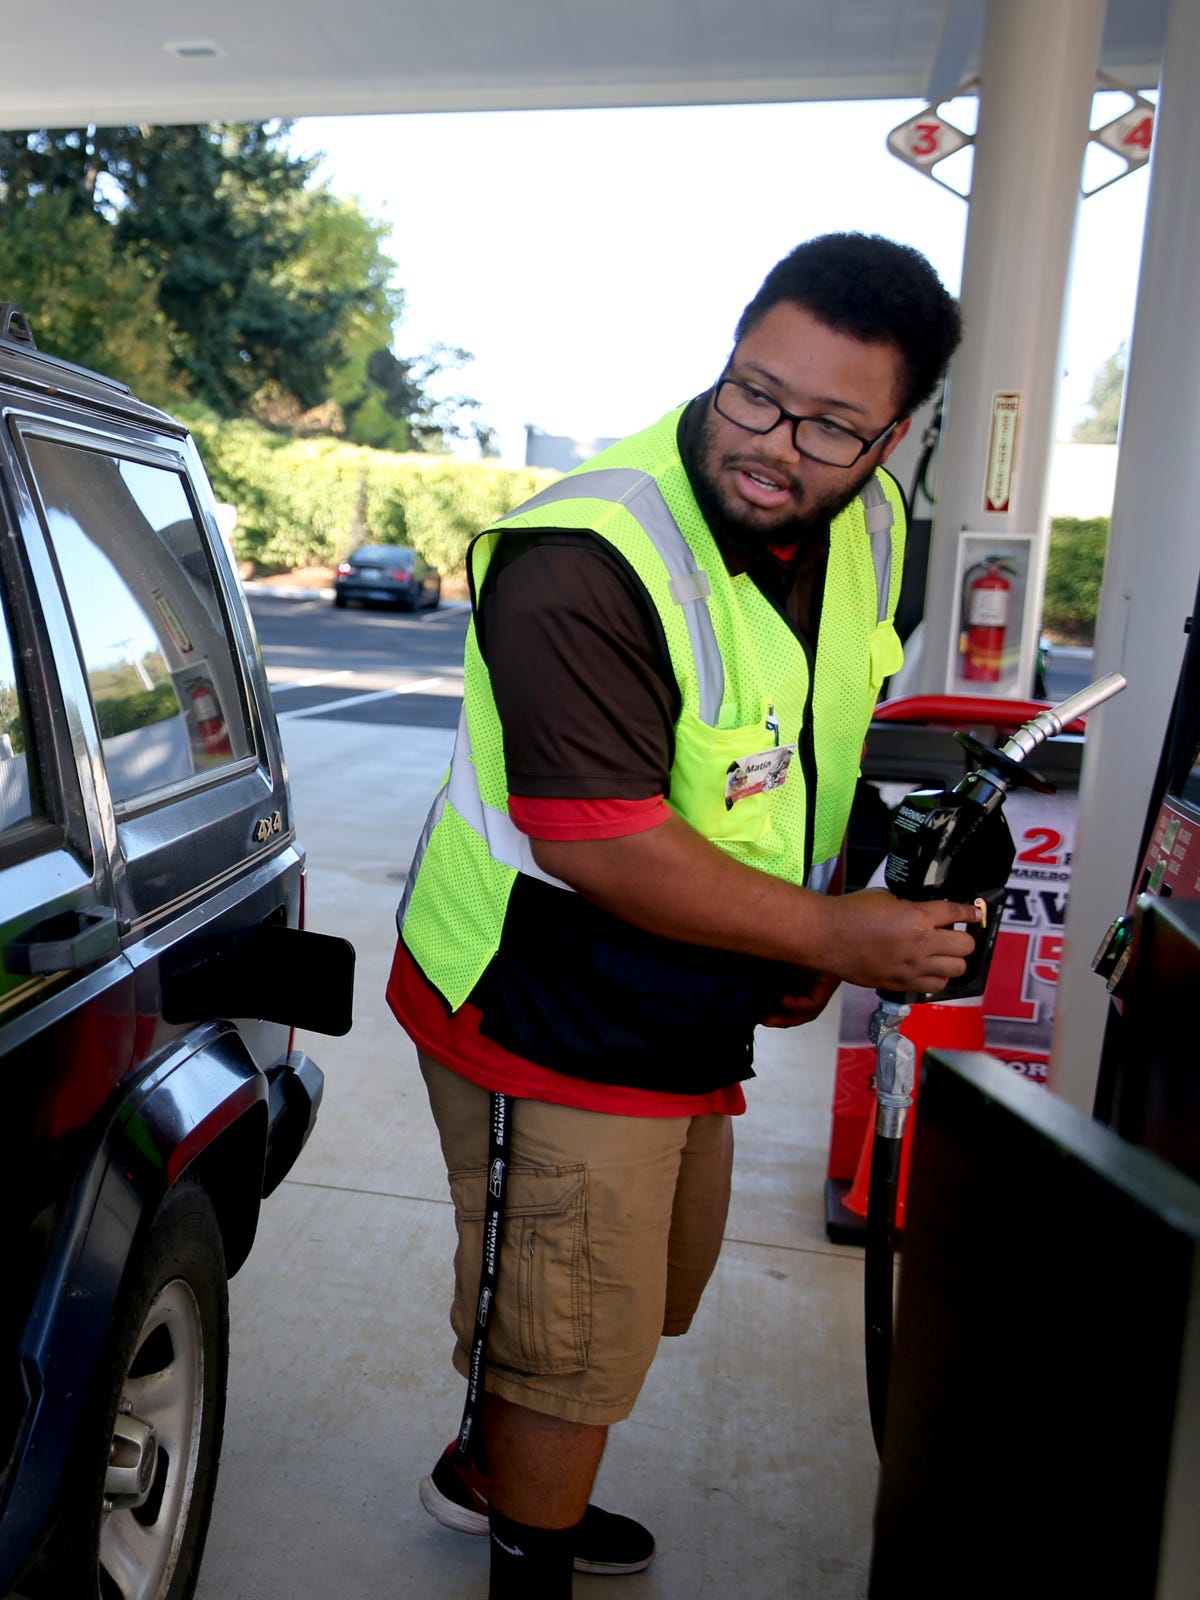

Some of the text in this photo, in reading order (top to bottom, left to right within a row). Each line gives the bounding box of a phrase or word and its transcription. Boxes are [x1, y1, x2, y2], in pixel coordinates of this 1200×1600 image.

[910, 124, 941, 156] 3
[1123, 117, 1152, 149] 4
[899, 806, 926, 823] WARNING
[1017, 827, 1062, 865] 2
[1003, 888, 1068, 925] AV
[488, 1210, 499, 1275] SEAHAWKS
